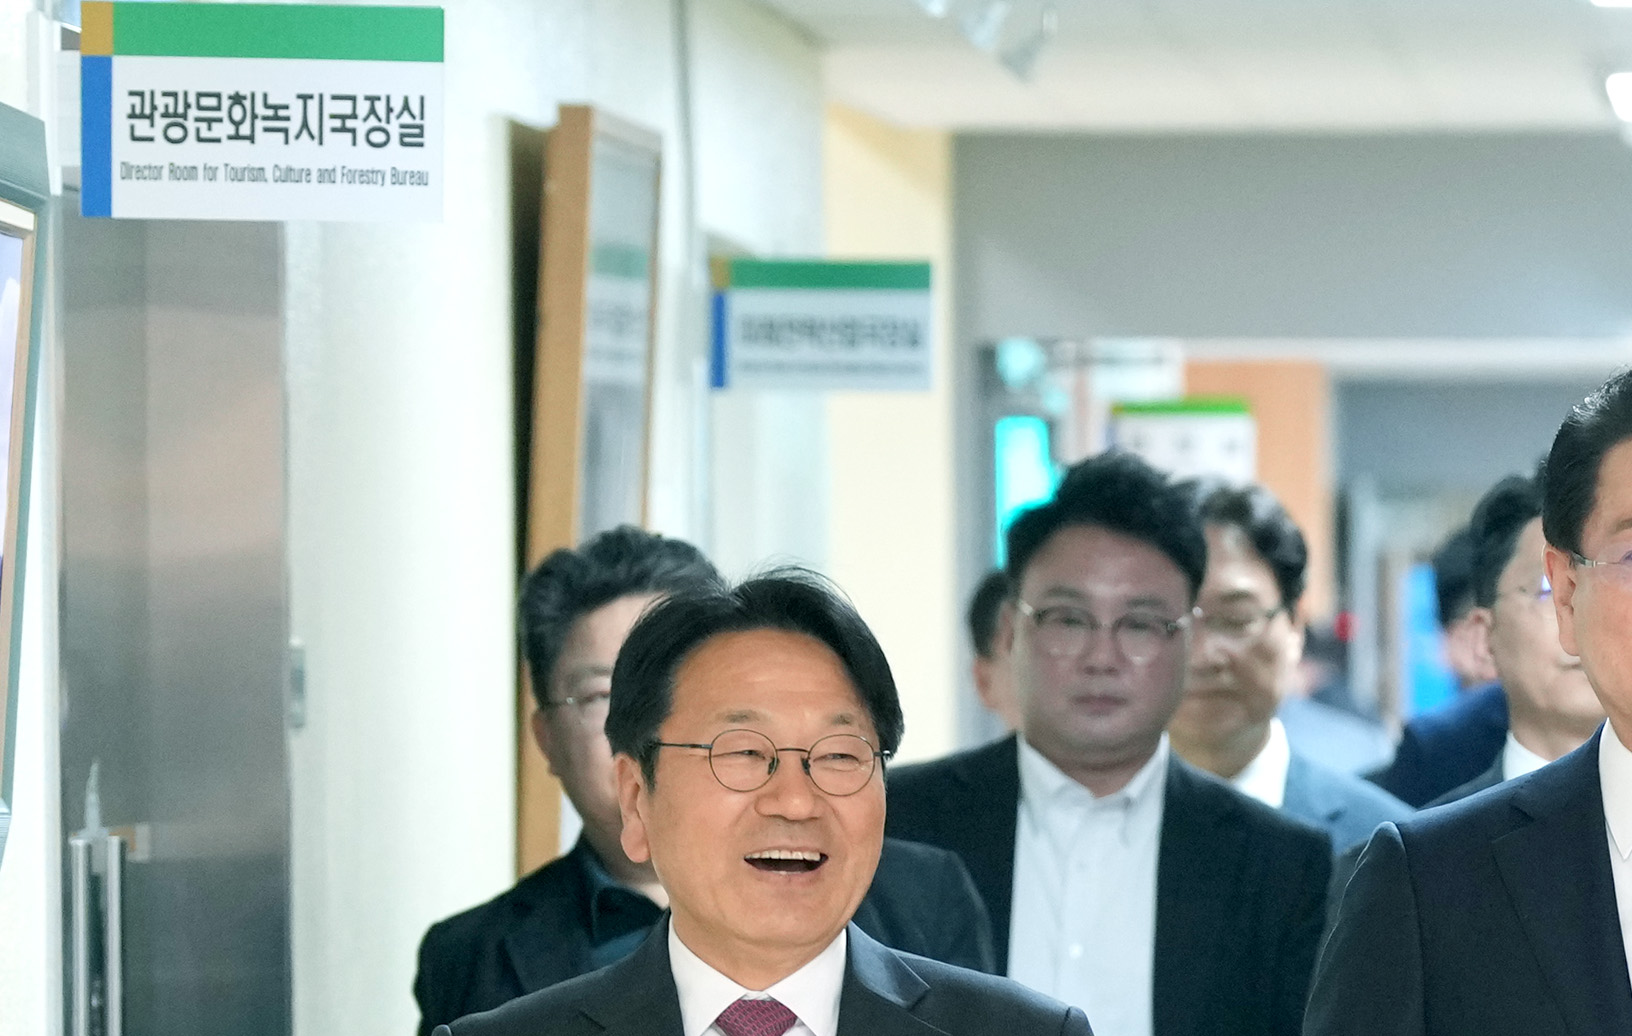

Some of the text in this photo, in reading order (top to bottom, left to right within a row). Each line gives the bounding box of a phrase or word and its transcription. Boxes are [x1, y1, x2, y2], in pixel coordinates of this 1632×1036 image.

[126, 89, 426, 149] 관광문화녹지국장실
[120, 161, 164, 181] Director
[168, 162, 198, 181] Room
[203, 163, 219, 182] for
[272, 163, 312, 184] Culture
[316, 165, 336, 184] and
[341, 165, 386, 187] Forestry
[390, 166, 429, 186] Bureau
